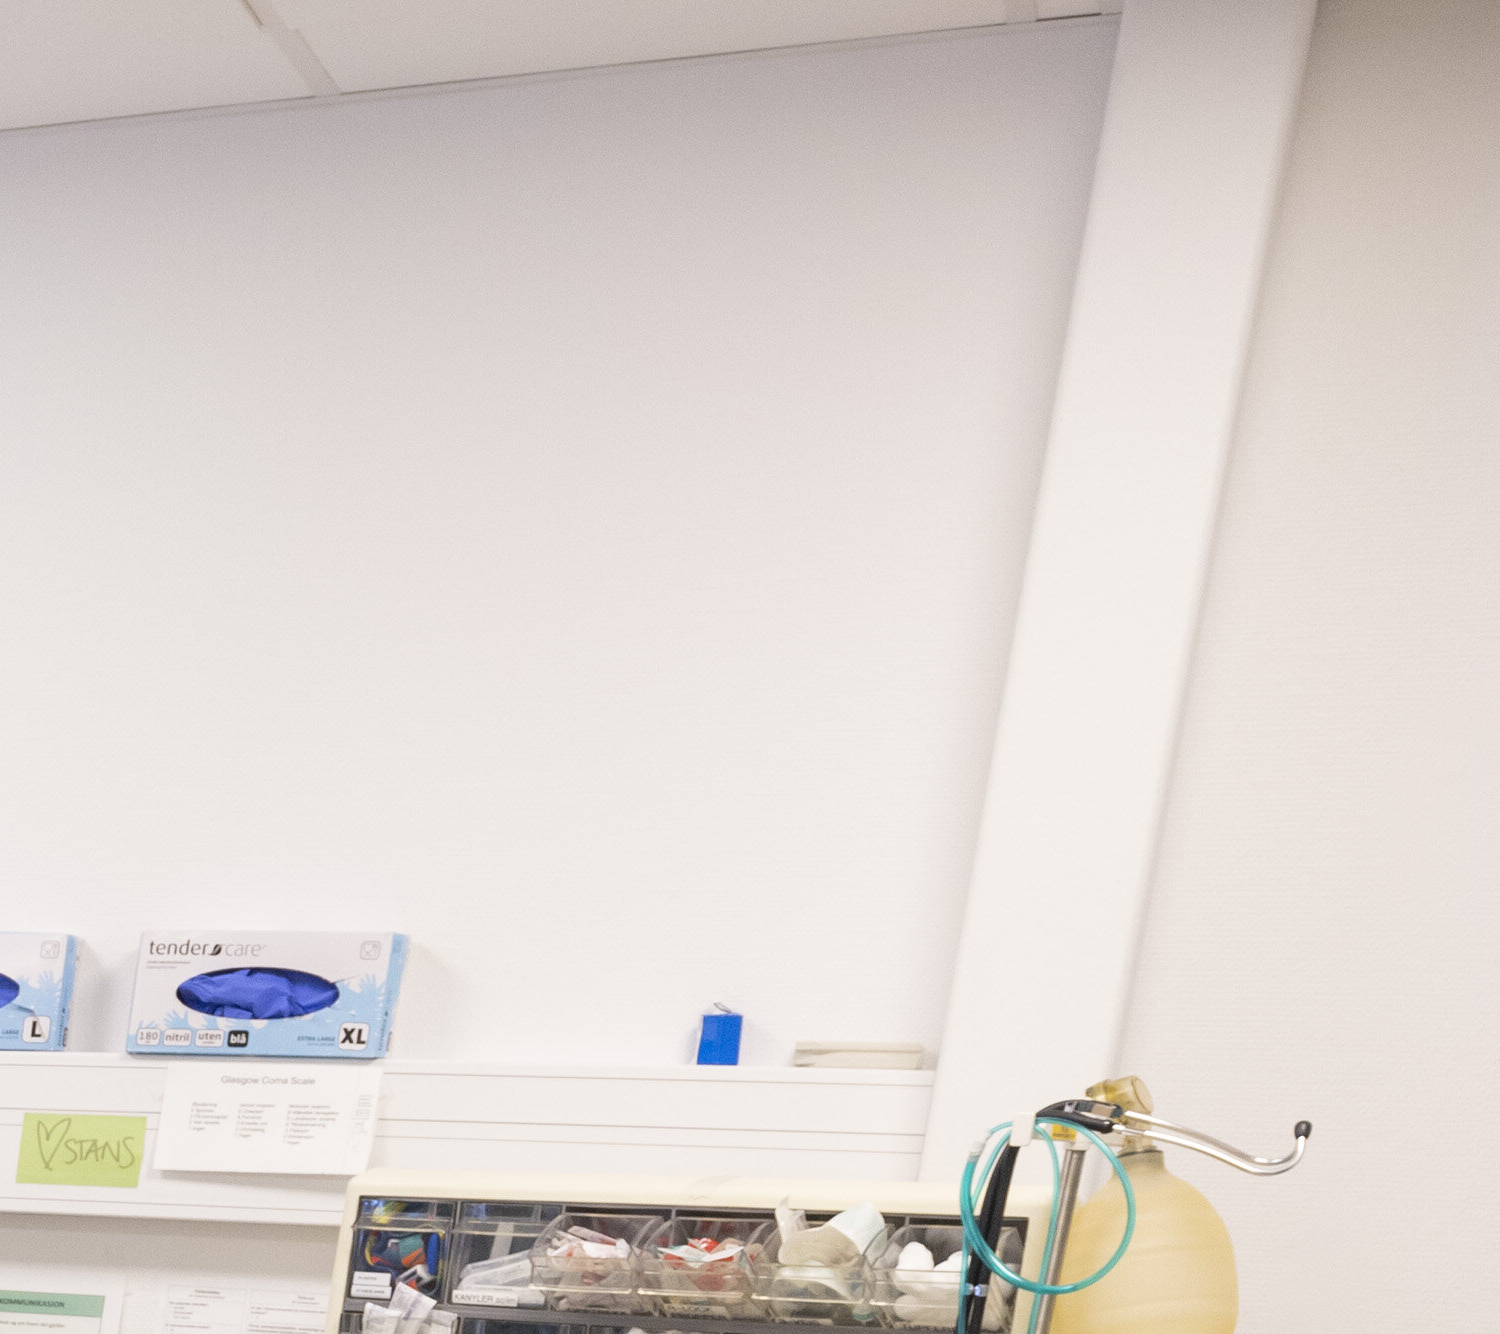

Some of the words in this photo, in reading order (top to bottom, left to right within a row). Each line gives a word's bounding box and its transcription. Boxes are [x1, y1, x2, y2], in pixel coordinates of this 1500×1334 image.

[149, 940, 207, 956] tender
[225, 941, 261, 957] care
[31, 1020, 42, 1038] L
[139, 1031, 158, 1041] 180
[165, 1031, 190, 1043] nitril
[198, 1032, 222, 1042] uten
[340, 1027, 367, 1045] XL
[221, 1075, 259, 1086] Glasgow
[262, 1076, 288, 1085] Coma
[291, 1077, 316, 1086] Scale
[454, 1292, 493, 1304] KANYLER
